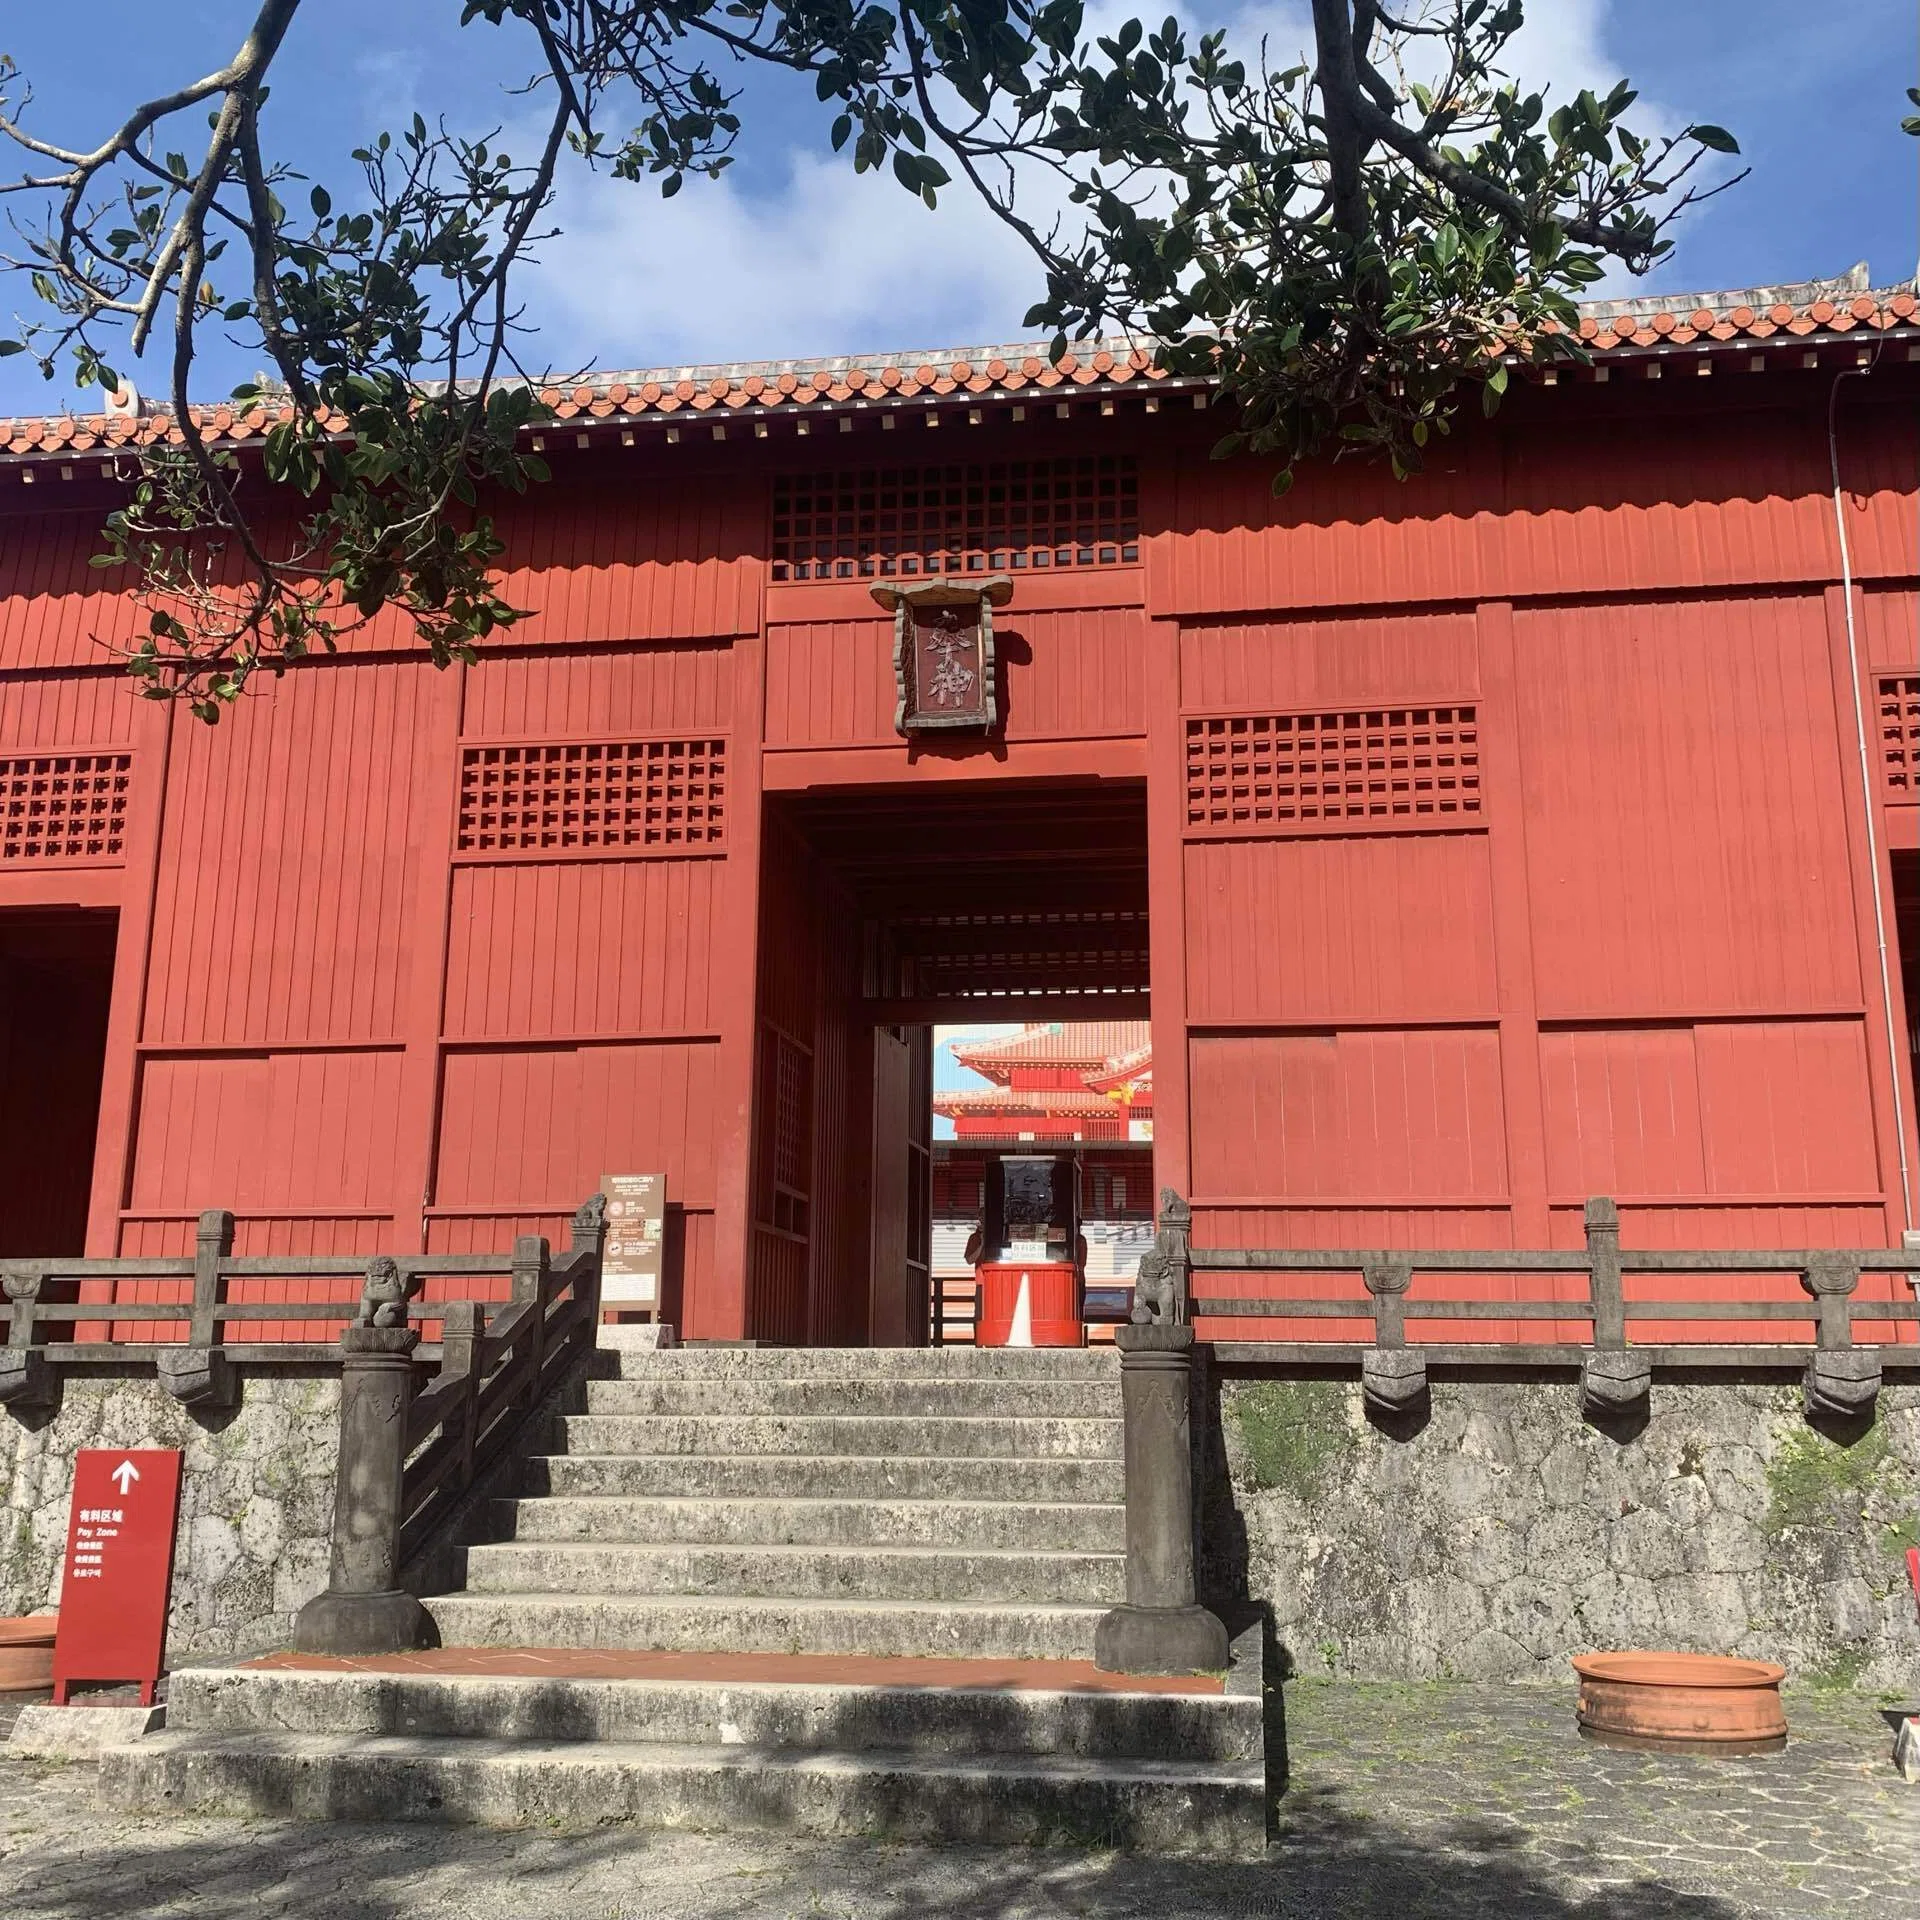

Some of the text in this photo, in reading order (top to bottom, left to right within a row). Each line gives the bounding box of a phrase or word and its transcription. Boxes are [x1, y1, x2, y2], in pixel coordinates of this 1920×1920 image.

[80, 1509, 123, 1523] 有料区域
[77, 1528, 118, 1538] Pay Zone
